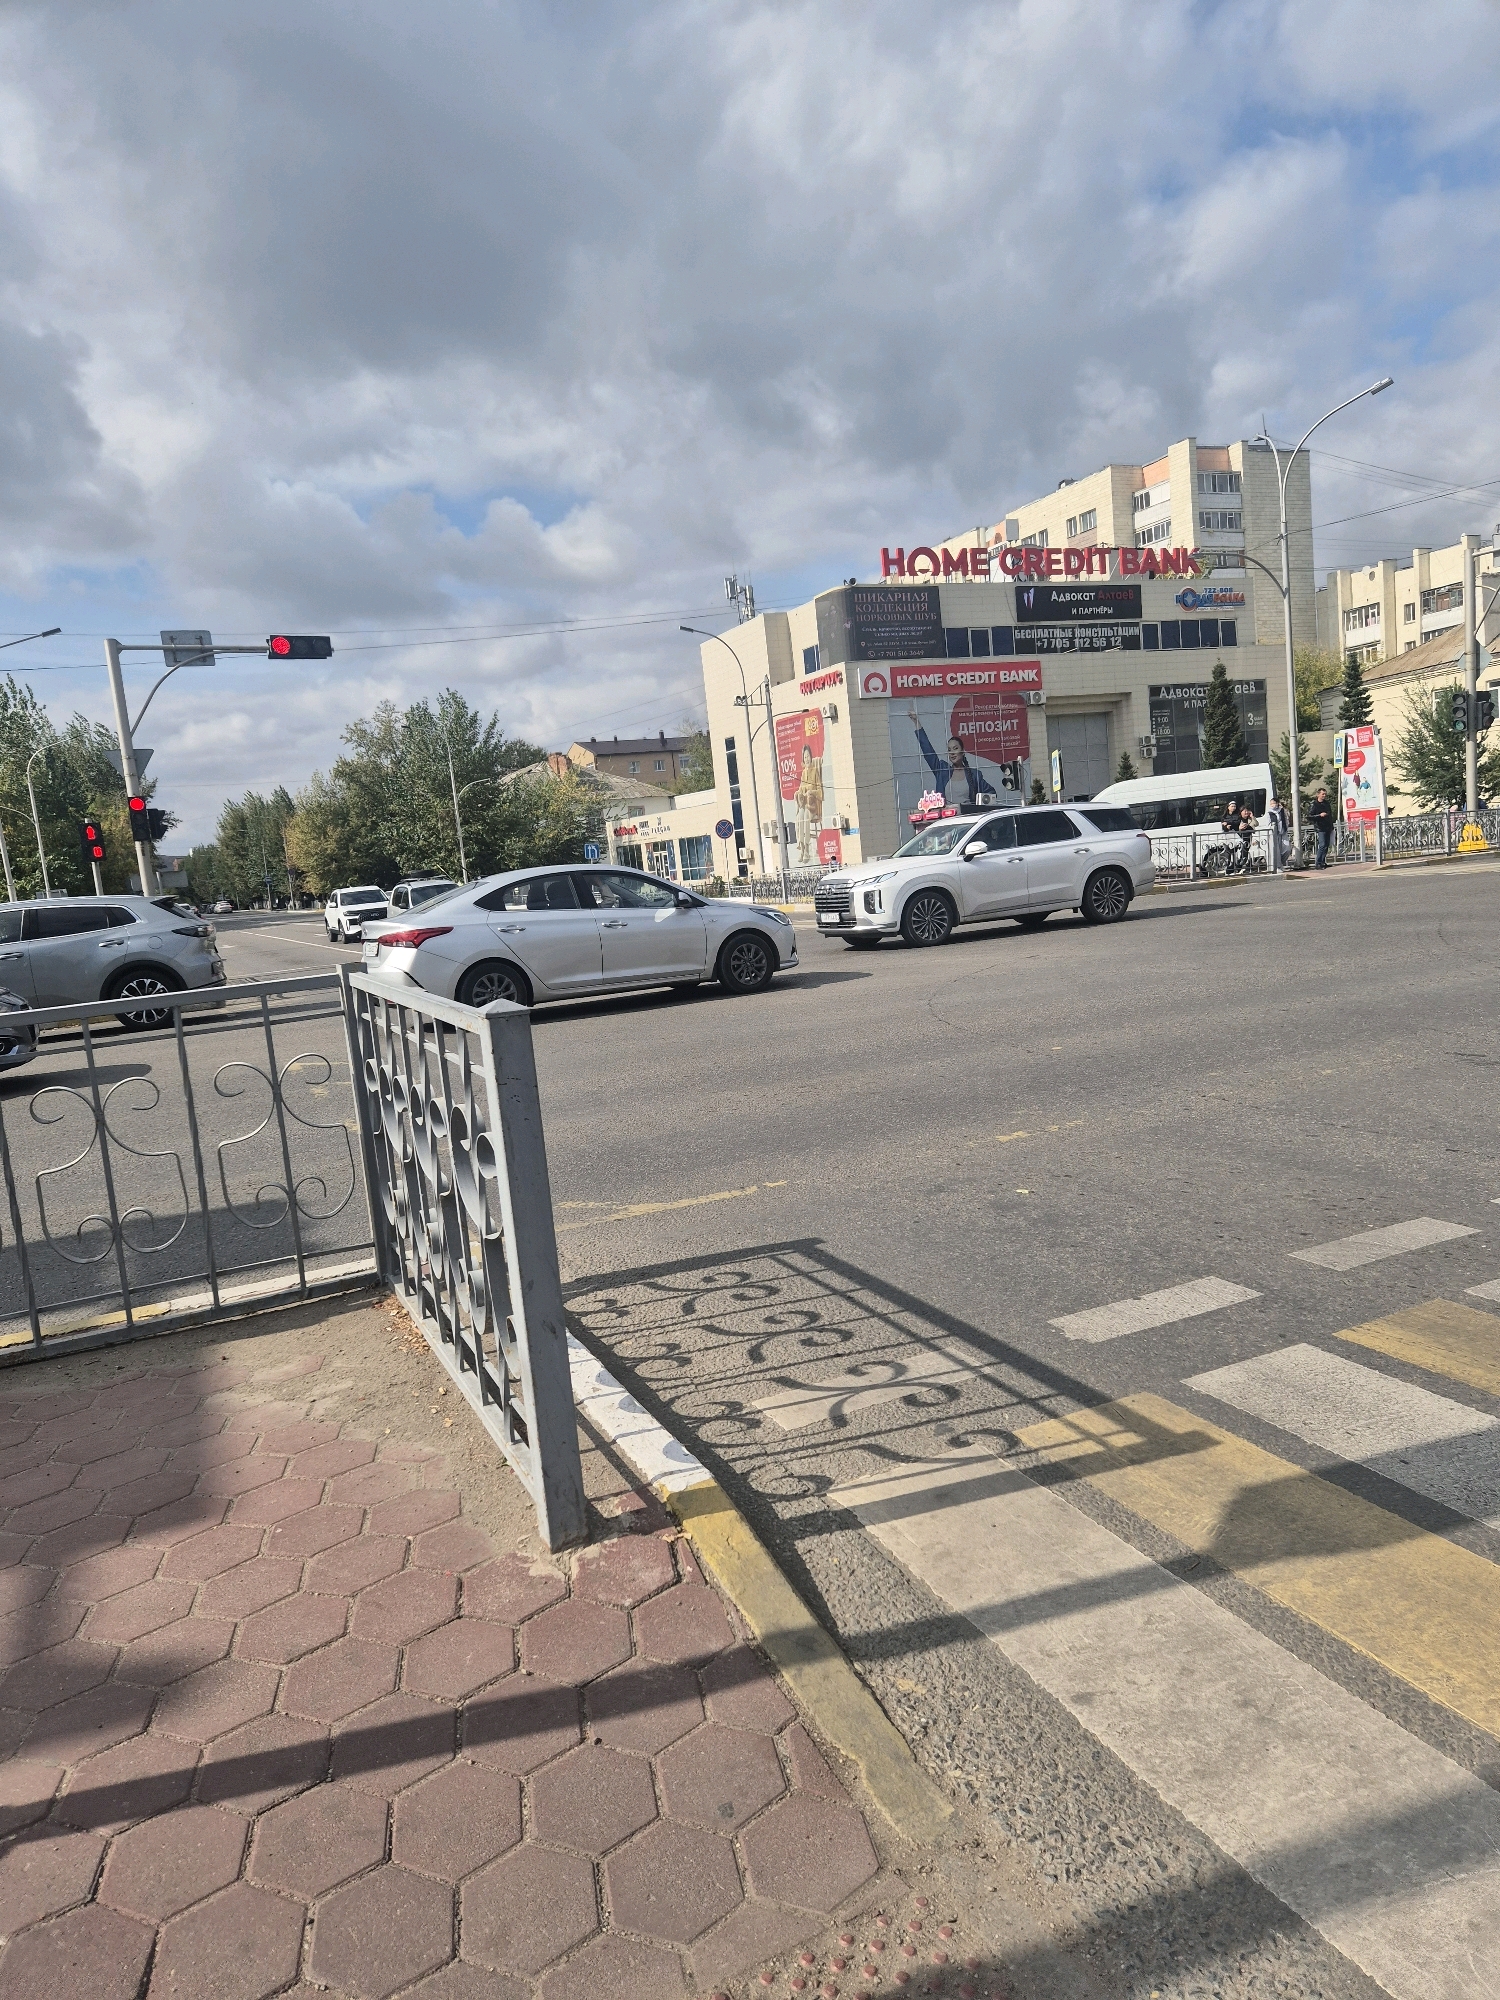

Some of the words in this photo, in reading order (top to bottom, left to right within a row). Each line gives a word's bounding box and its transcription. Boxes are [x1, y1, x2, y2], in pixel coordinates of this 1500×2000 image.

[880, 546, 990, 577] HOME
[999, 547, 1112, 576] CREDIT
[1118, 546, 1201, 575] BANK
[854, 592, 929, 603] ШИКАРНАЯ
[855, 602, 929, 613] КОЛЛЕКЦИЯ
[1078, 605, 1114, 615] ПАРТНЁРЫ
[856, 613, 913, 622] НОРКОВЫХ
[914, 612, 937, 621] ШУБ
[1014, 627, 1073, 639] БЕСПЛАТНЫЕ
[1036, 639, 1048, 649] +7
[1049, 638, 1070, 648] 705
[1073, 638, 1091, 648] 112
[1092, 637, 1107, 648] 56
[1109, 636, 1122, 646] 12
[800, 670, 843, 696] НОТАРИУС
[896, 673, 944, 688] HOME
[945, 670, 998, 686] CREDIT
[1000, 669, 1039, 683] BANK
[1247, 713, 1254, 726] 3
[958, 719, 1019, 736] ДЕПОЗИТ
[781, 758, 797, 773] 10%
[823, 840, 837, 848] HOME
[824, 846, 839, 854] CREDIT
